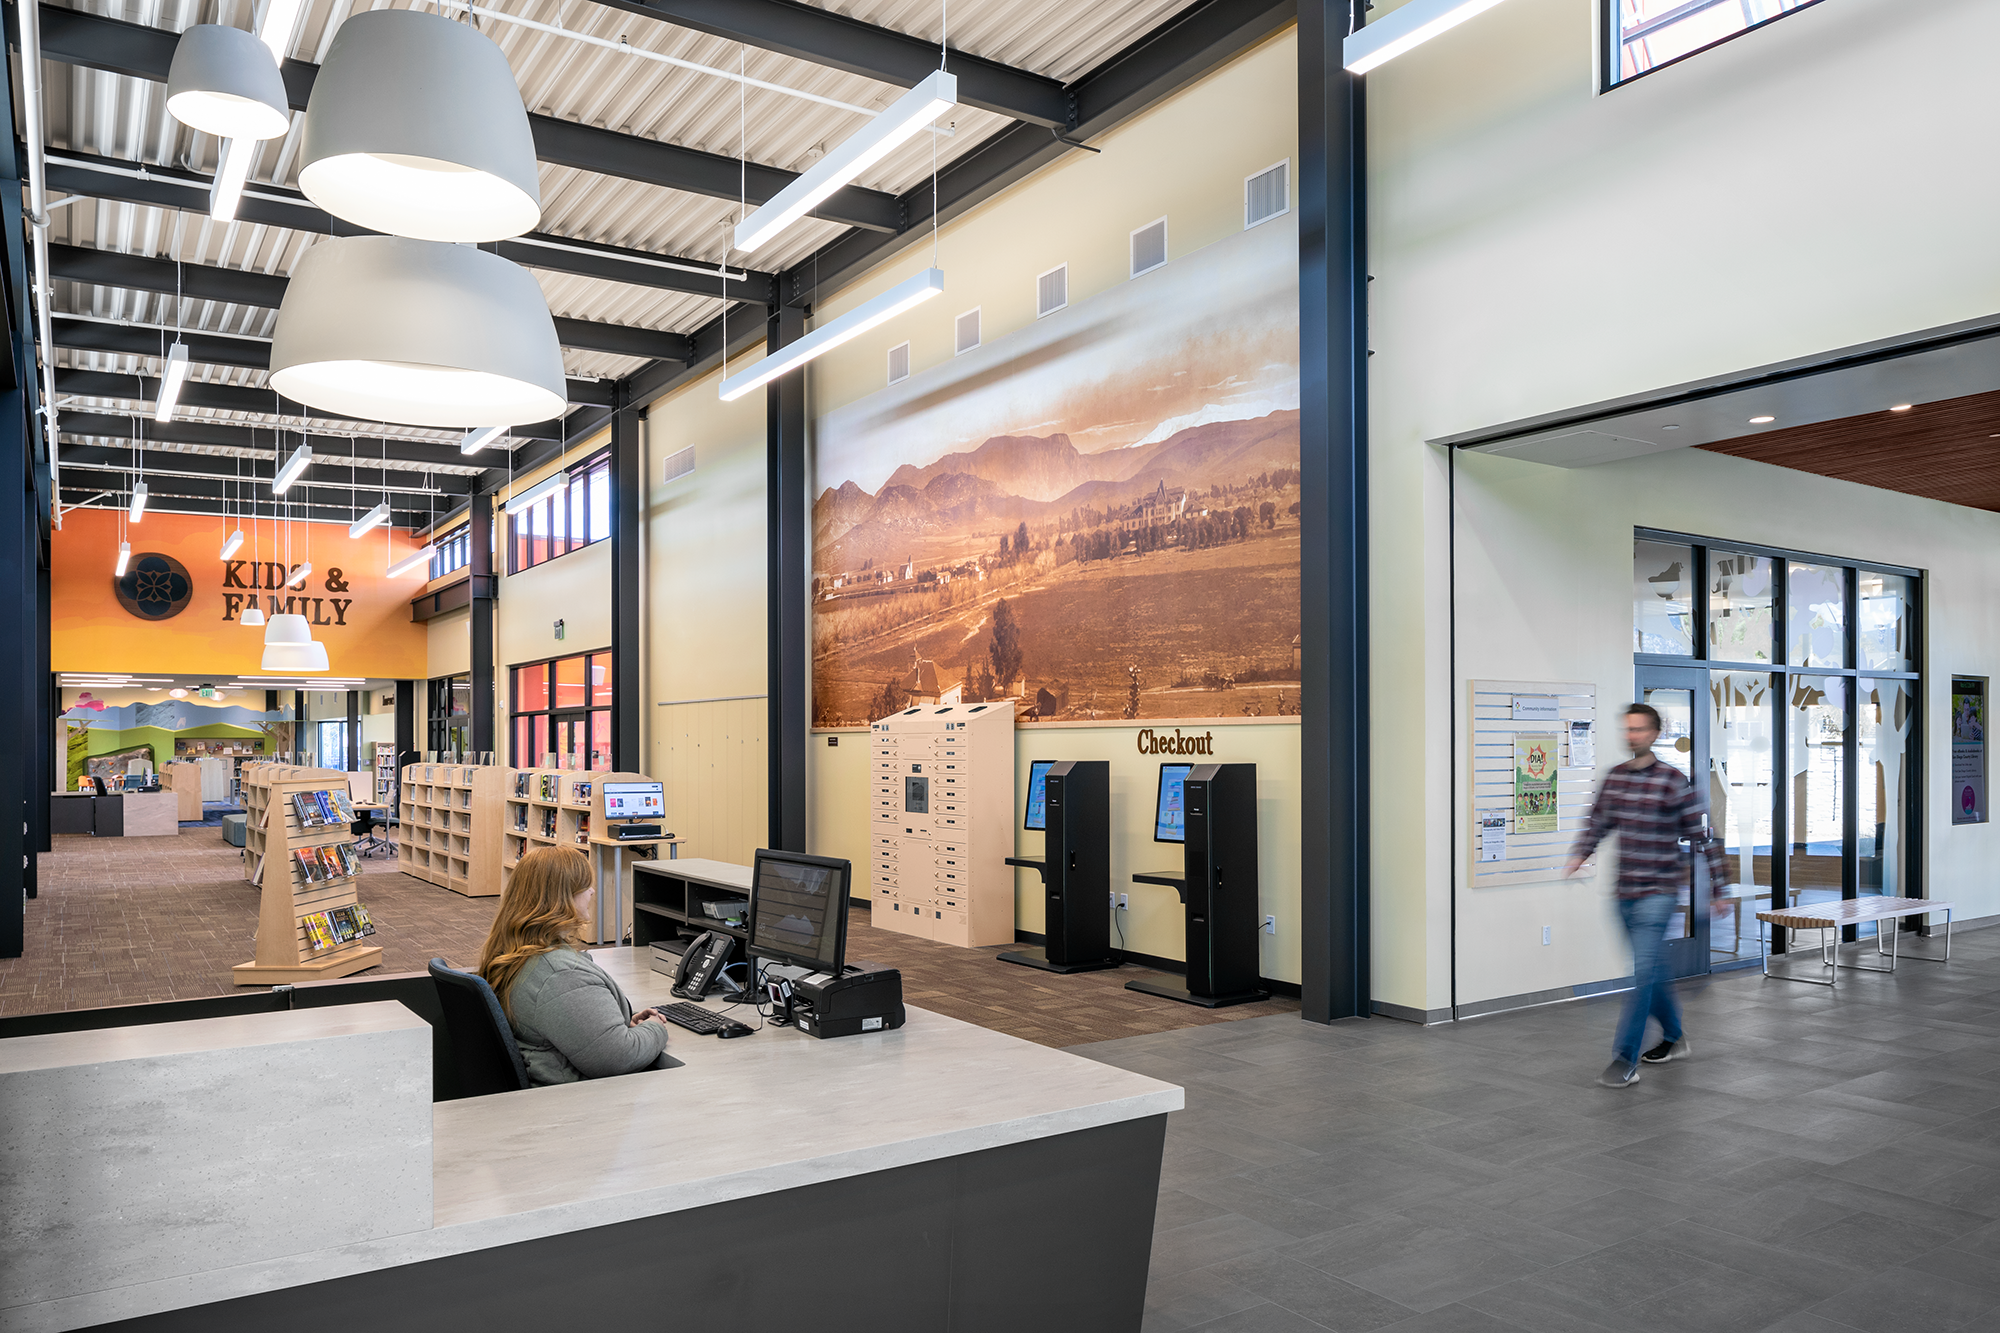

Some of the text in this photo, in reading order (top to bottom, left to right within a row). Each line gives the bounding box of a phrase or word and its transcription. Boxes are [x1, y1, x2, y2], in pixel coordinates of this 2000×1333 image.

[325, 567, 349, 593] &
[201, 689, 213, 697] EXIT
[1138, 728, 1213, 755] Checkout
[1530, 754, 1543, 764] DIA!
